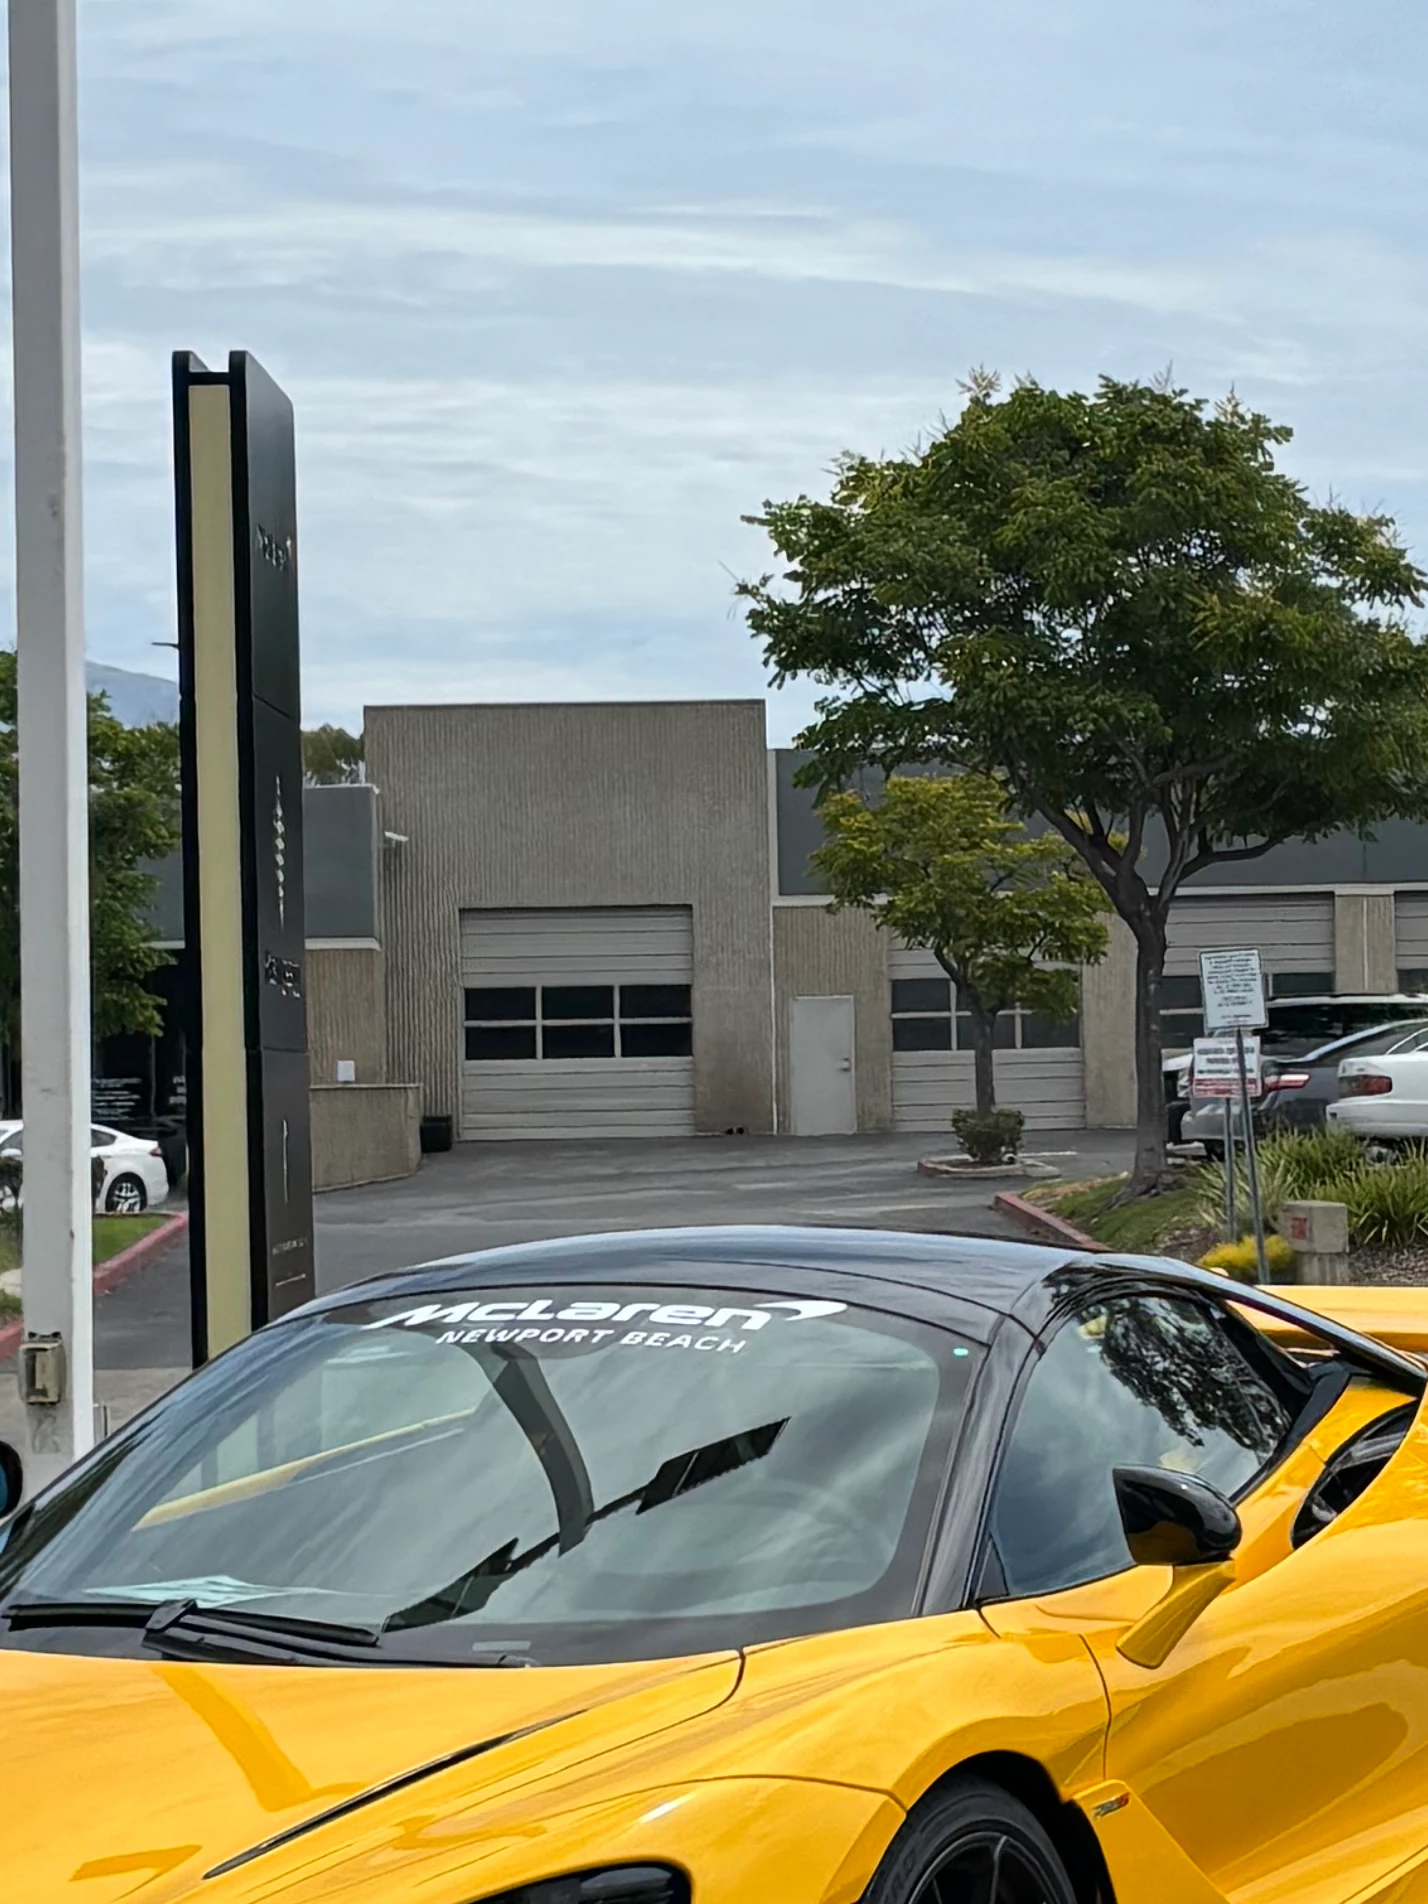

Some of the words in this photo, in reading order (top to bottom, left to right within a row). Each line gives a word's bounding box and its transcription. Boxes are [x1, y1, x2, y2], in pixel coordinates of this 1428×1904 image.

[360, 1299, 773, 1330] McLaren
[435, 1329, 614, 1345] NEWPORT
[620, 1332, 746, 1353] BEACH
